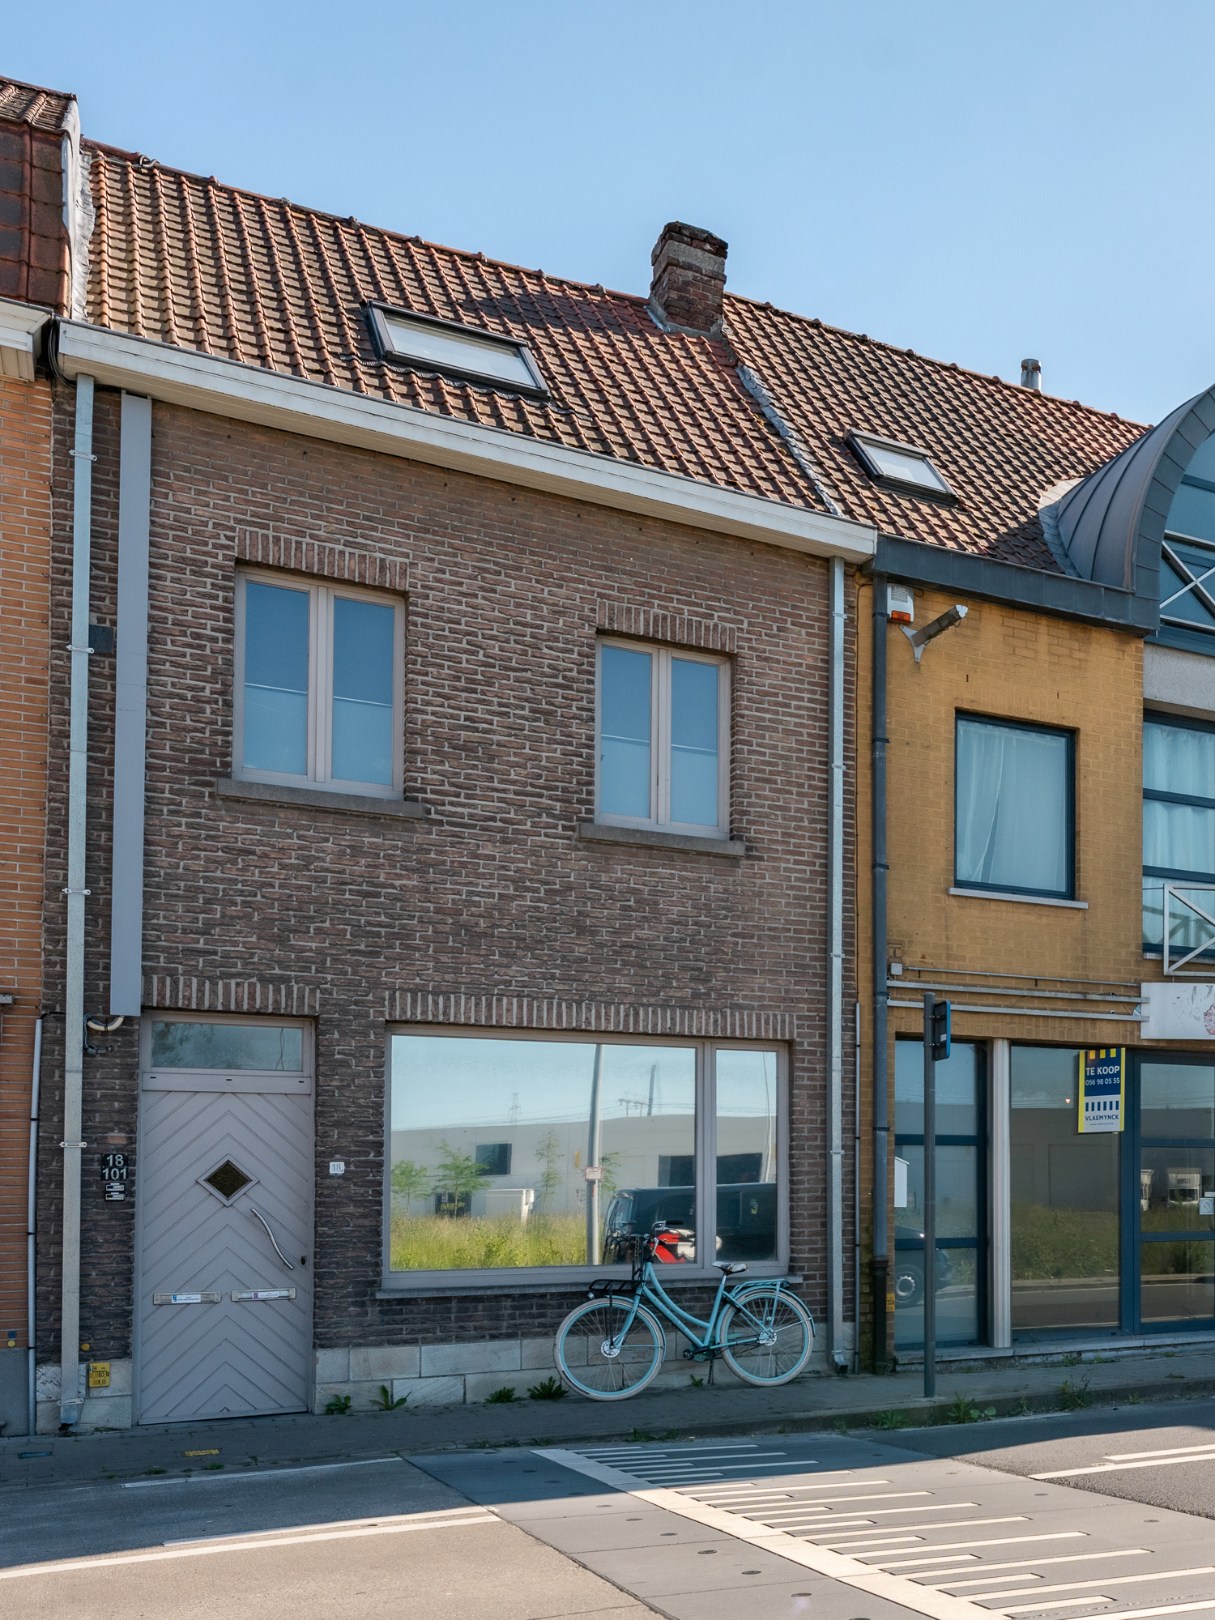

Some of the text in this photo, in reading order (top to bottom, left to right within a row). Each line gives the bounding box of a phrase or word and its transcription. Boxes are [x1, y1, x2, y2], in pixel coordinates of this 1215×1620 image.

[1086, 1066, 1120, 1076] TE KOOP
[107, 1154, 124, 1166] 18
[102, 1167, 127, 1180] 101
